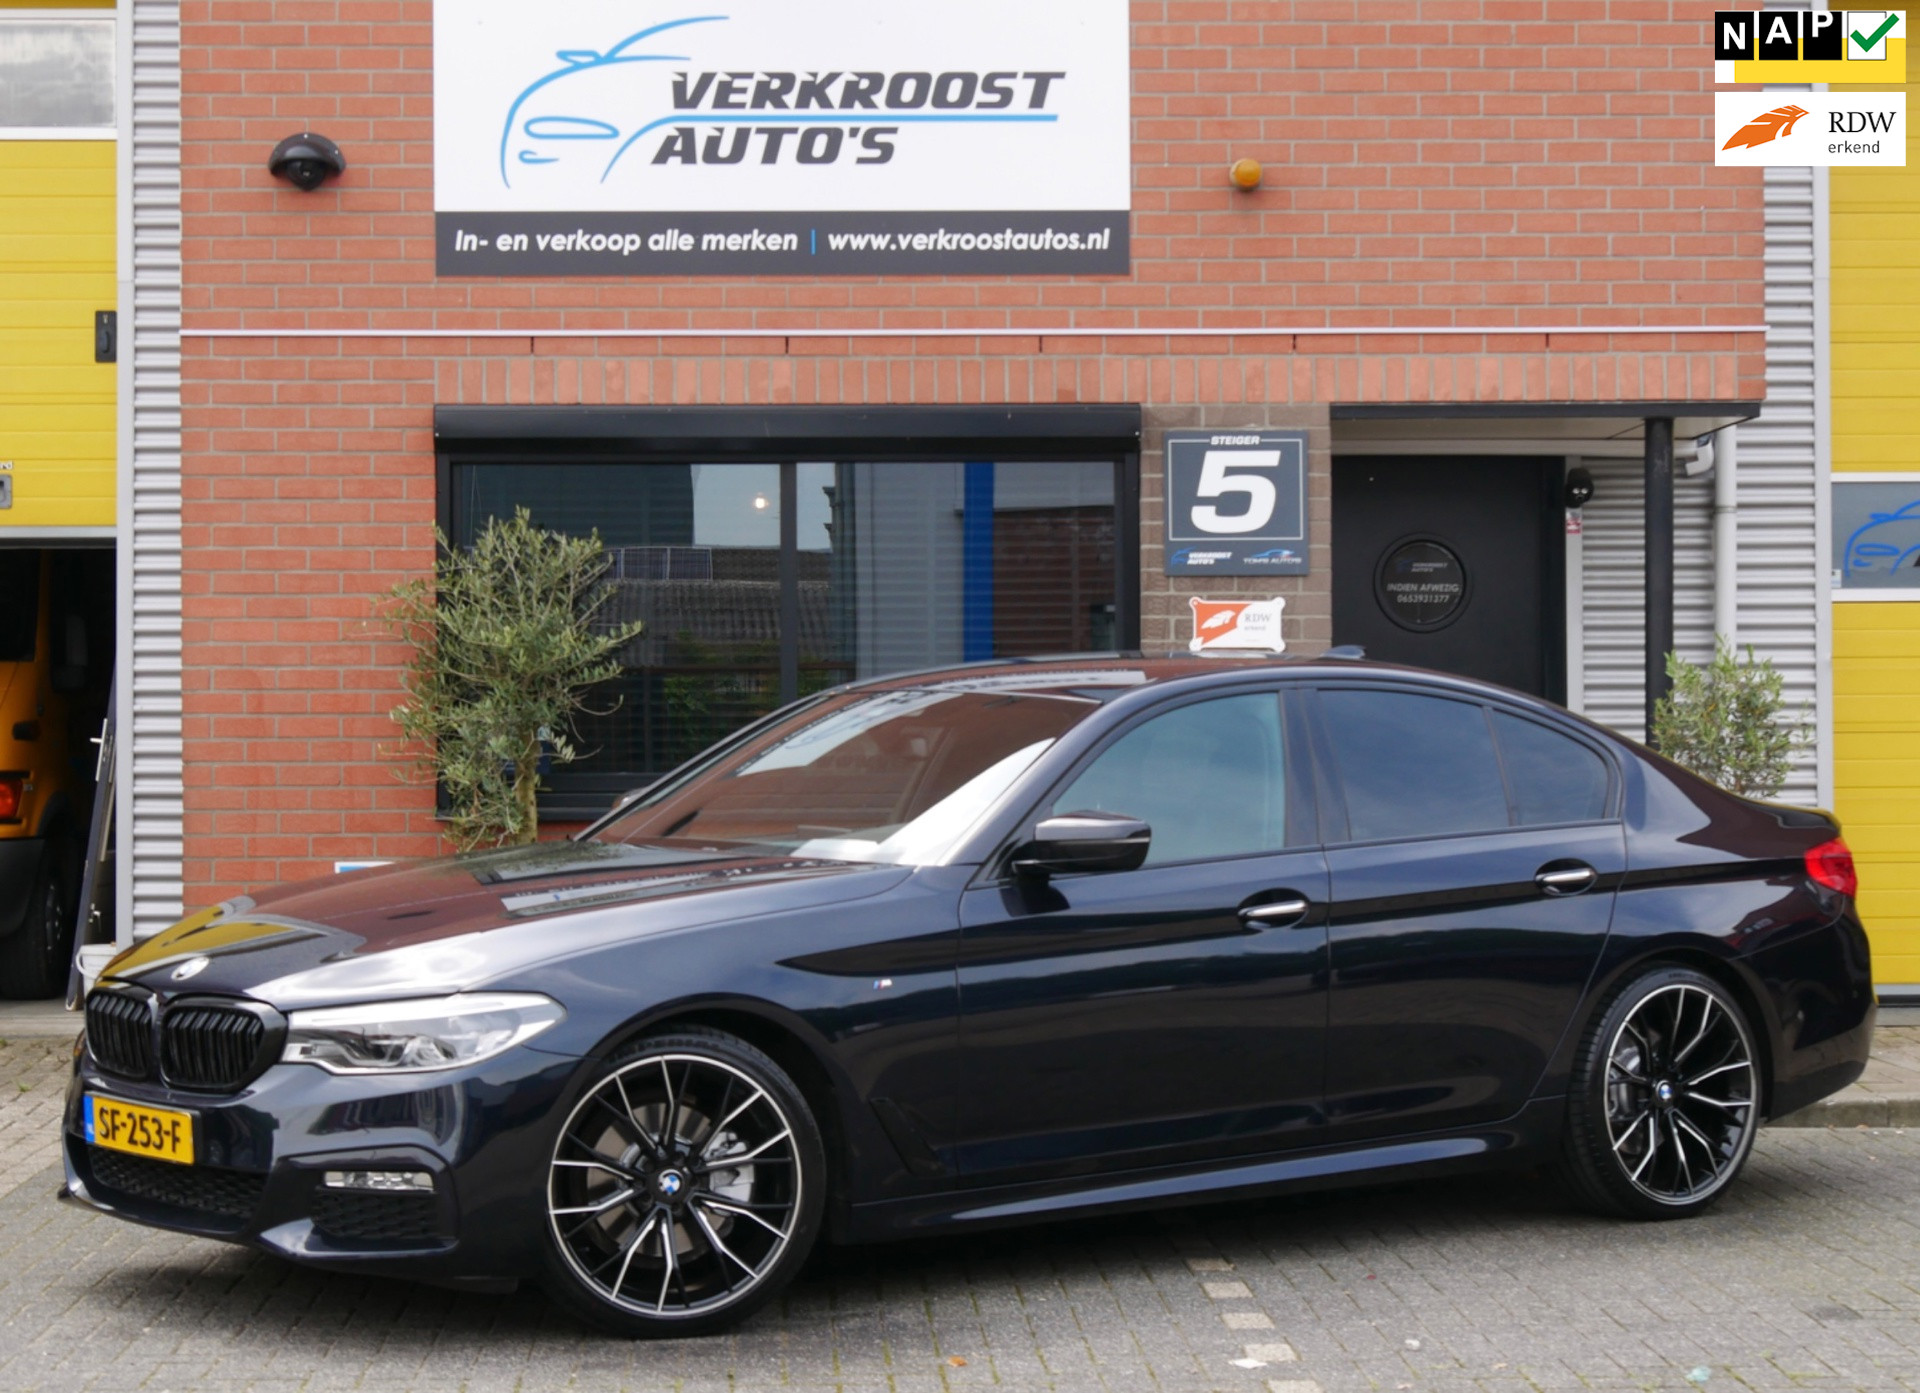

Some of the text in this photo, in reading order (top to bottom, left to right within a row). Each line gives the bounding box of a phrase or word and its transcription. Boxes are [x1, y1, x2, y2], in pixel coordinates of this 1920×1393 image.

[671, 71, 1066, 110] VERKROOST
[651, 126, 899, 165] AUTO'S
[455, 228, 1111, 256] In- en verkoop alle merken www.verkroostautos.nl
[1211, 435, 1260, 446] STEIGER
[1191, 450, 1281, 534] 5
[99, 1106, 181, 1153] SF-253-F
